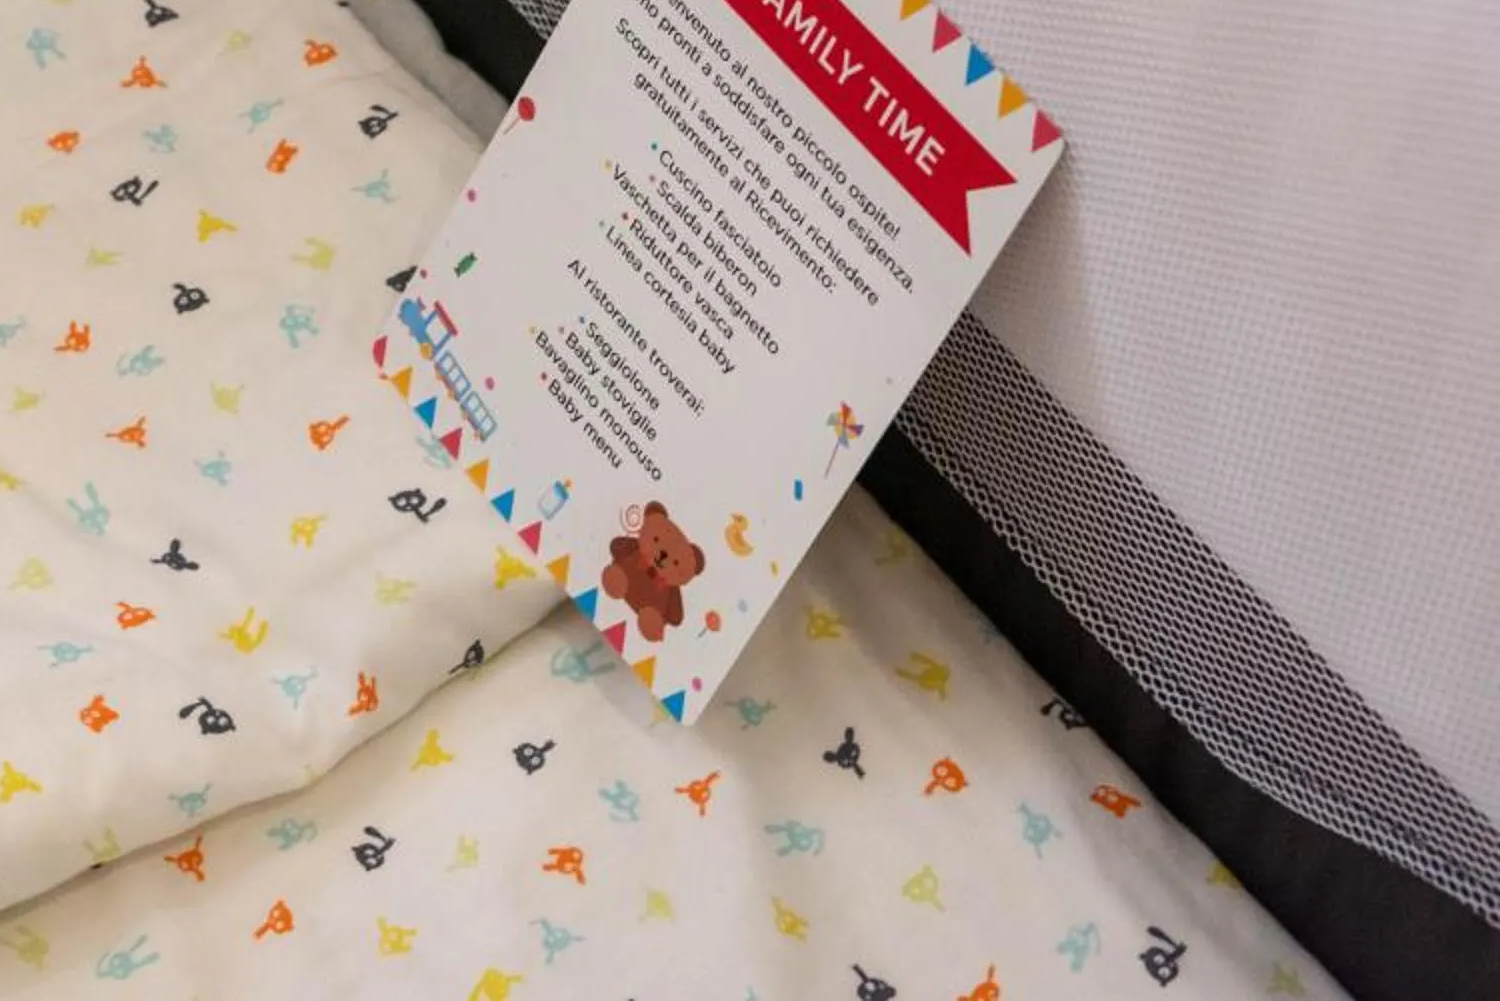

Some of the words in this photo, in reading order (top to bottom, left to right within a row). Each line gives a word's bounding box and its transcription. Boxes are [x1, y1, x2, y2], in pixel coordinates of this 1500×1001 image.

[615, 17, 661, 70] Scopri
[659, 64, 691, 103] tutti
[697, 108, 744, 161] servizi
[743, 158, 771, 190] che
[768, 187, 806, 227] puoi
[804, 224, 879, 306] richiedere
[633, 72, 729, 177] gratuitamente
[728, 175, 747, 194] al
[744, 188, 836, 293] Ricevimento:
[656, 16, 702, 64] pronti
[700, 61, 712, 77] a
[712, 73, 785, 154] soddisfare
[785, 151, 821, 190] ogni
[820, 185, 845, 219] tua
[846, 216, 913, 294] esigenza.
[730, 59, 748, 79] al
[745, 76, 793, 128] nostro
[791, 125, 847, 185] piccolo
[847, 183, 901, 240] ospite!
[863, 75, 945, 176] TIME
[613, 162, 677, 243] Vaschetta
[675, 240, 704, 269] per
[702, 266, 716, 283] il
[713, 278, 779, 354] bagnetto
[628, 217, 693, 294] Riduttore
[694, 291, 734, 340] vasca
[655, 179, 703, 237] Scalda
[702, 229, 757, 297] biberon
[658, 149, 713, 213] Cuscino
[712, 208, 781, 287] fasciatoio
[566, 258, 587, 279] Al
[583, 277, 647, 352] ristorante
[648, 348, 704, 416] troverai:
[585, 321, 660, 410] Seggiolone
[605, 224, 643, 272] Linea
[643, 270, 698, 334] cortesia
[697, 327, 735, 374] baby
[534, 330, 599, 408] Bavaglino
[598, 407, 662, 481] monouso
[547, 378, 584, 423] Baby
[582, 421, 622, 468] menu
[564, 330, 601, 376] Baby
[600, 374, 657, 441] stoviglie
